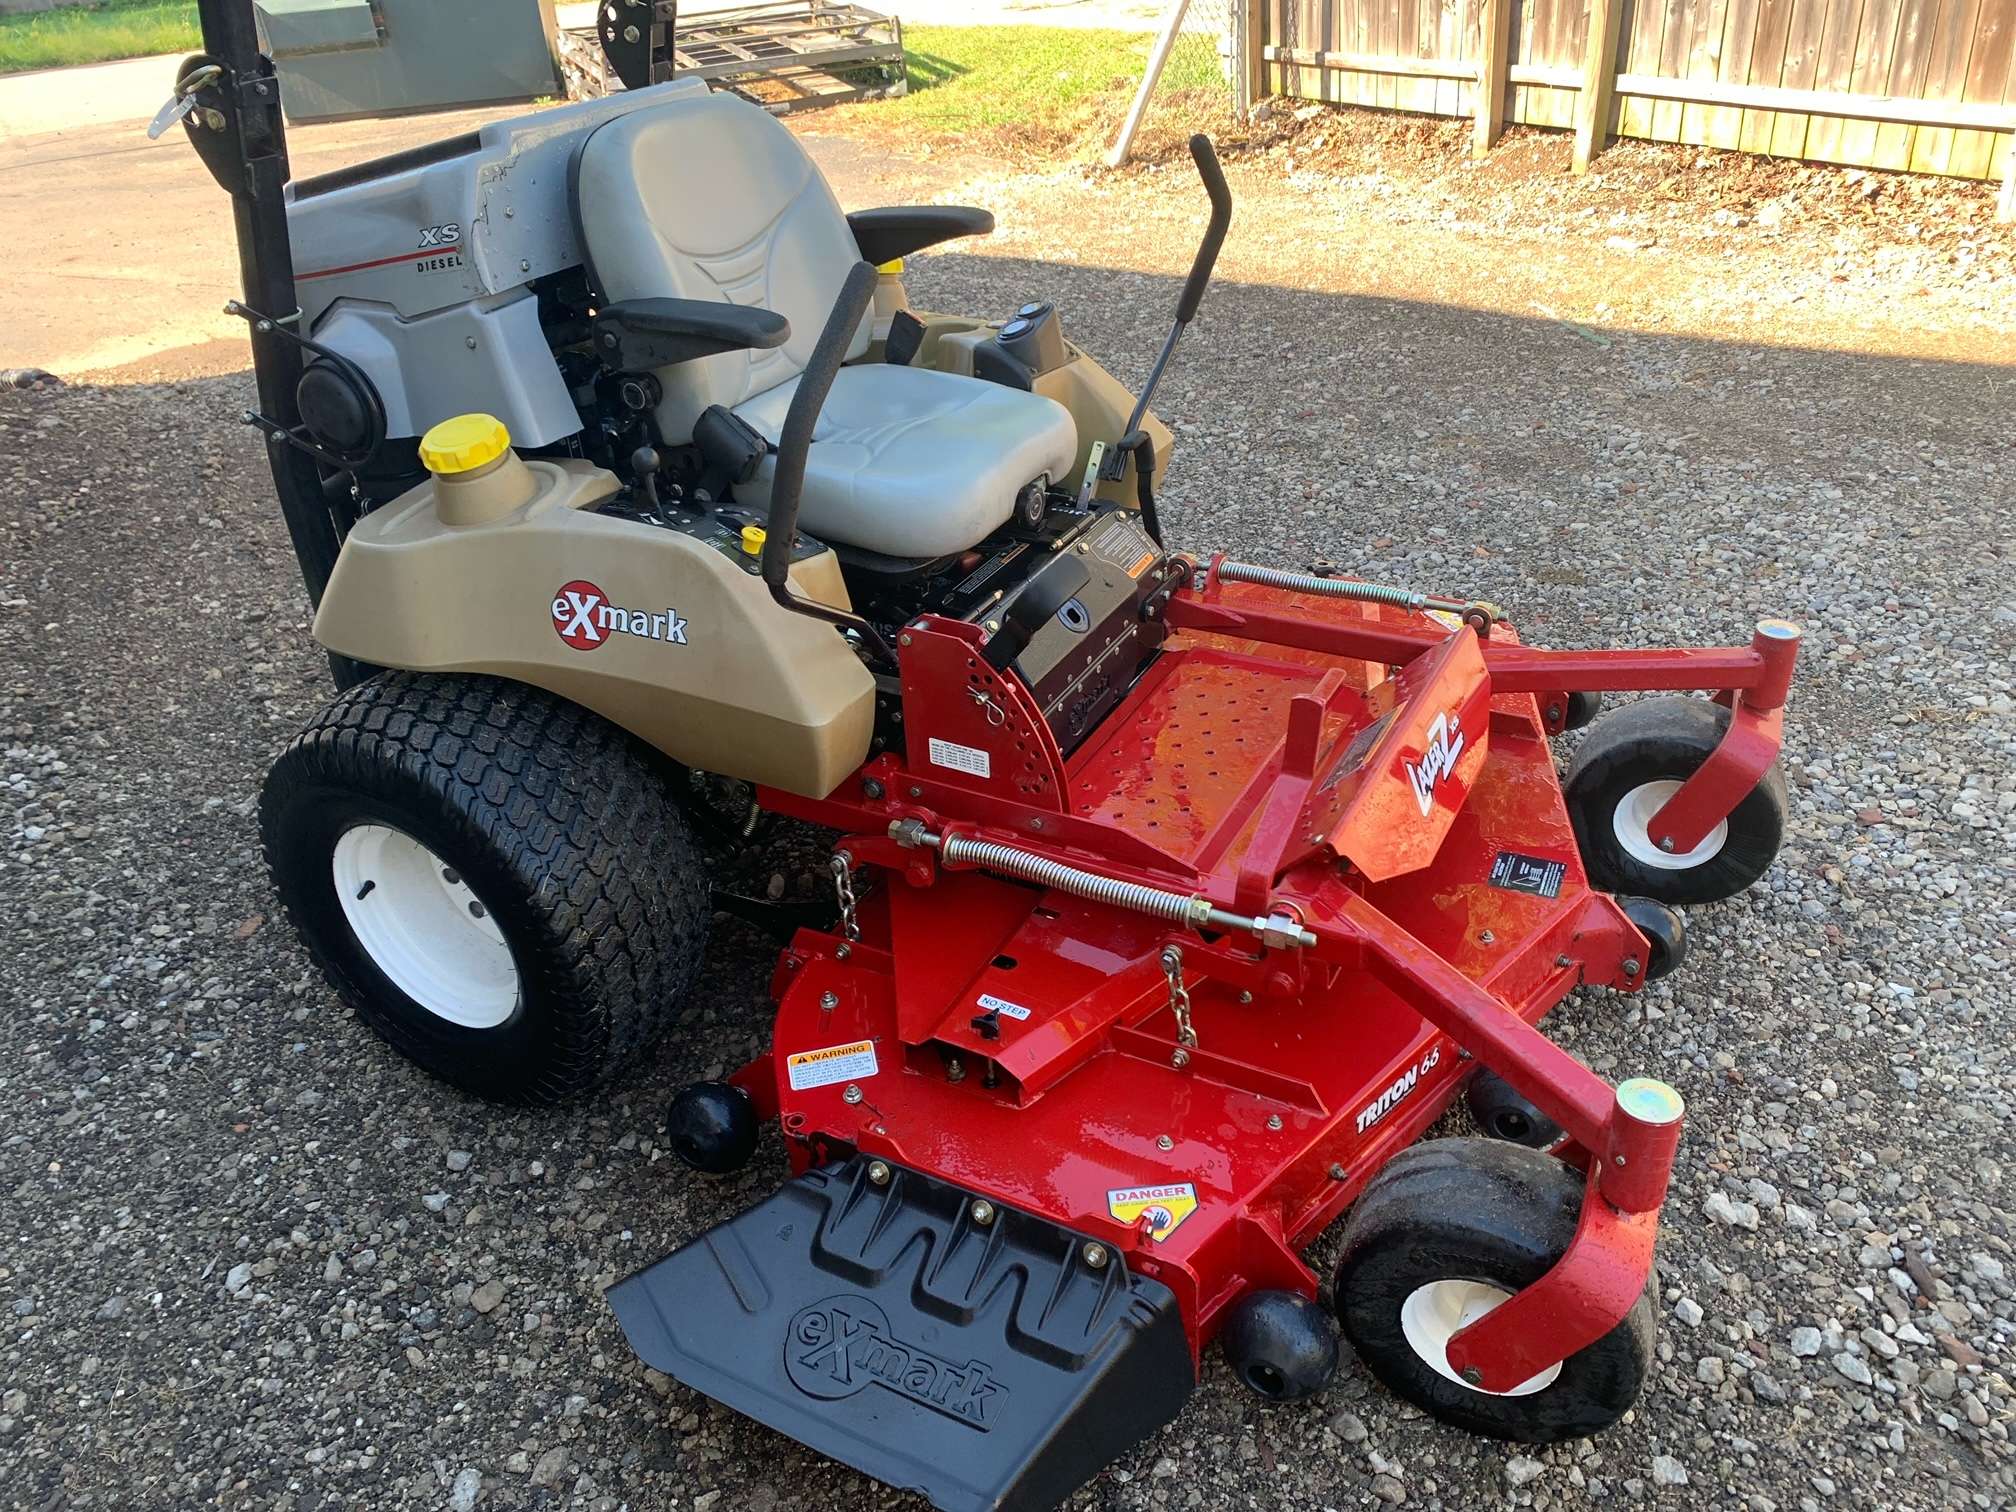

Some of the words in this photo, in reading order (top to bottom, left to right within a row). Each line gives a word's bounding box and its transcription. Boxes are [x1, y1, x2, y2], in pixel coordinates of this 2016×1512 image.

[417, 223, 460, 248] XS
[417, 256, 463, 273] DIESEL
[551, 590, 688, 645] eXmark
[981, 997, 998, 1007] NO
[998, 1002, 1026, 1016] STEP
[810, 1045, 865, 1062] WARNING
[1356, 1063, 1418, 1135] TRITON
[1420, 1046, 1440, 1076] 66
[1115, 1186, 1187, 1202] DANGER
[797, 1307, 998, 1422] eXmark
